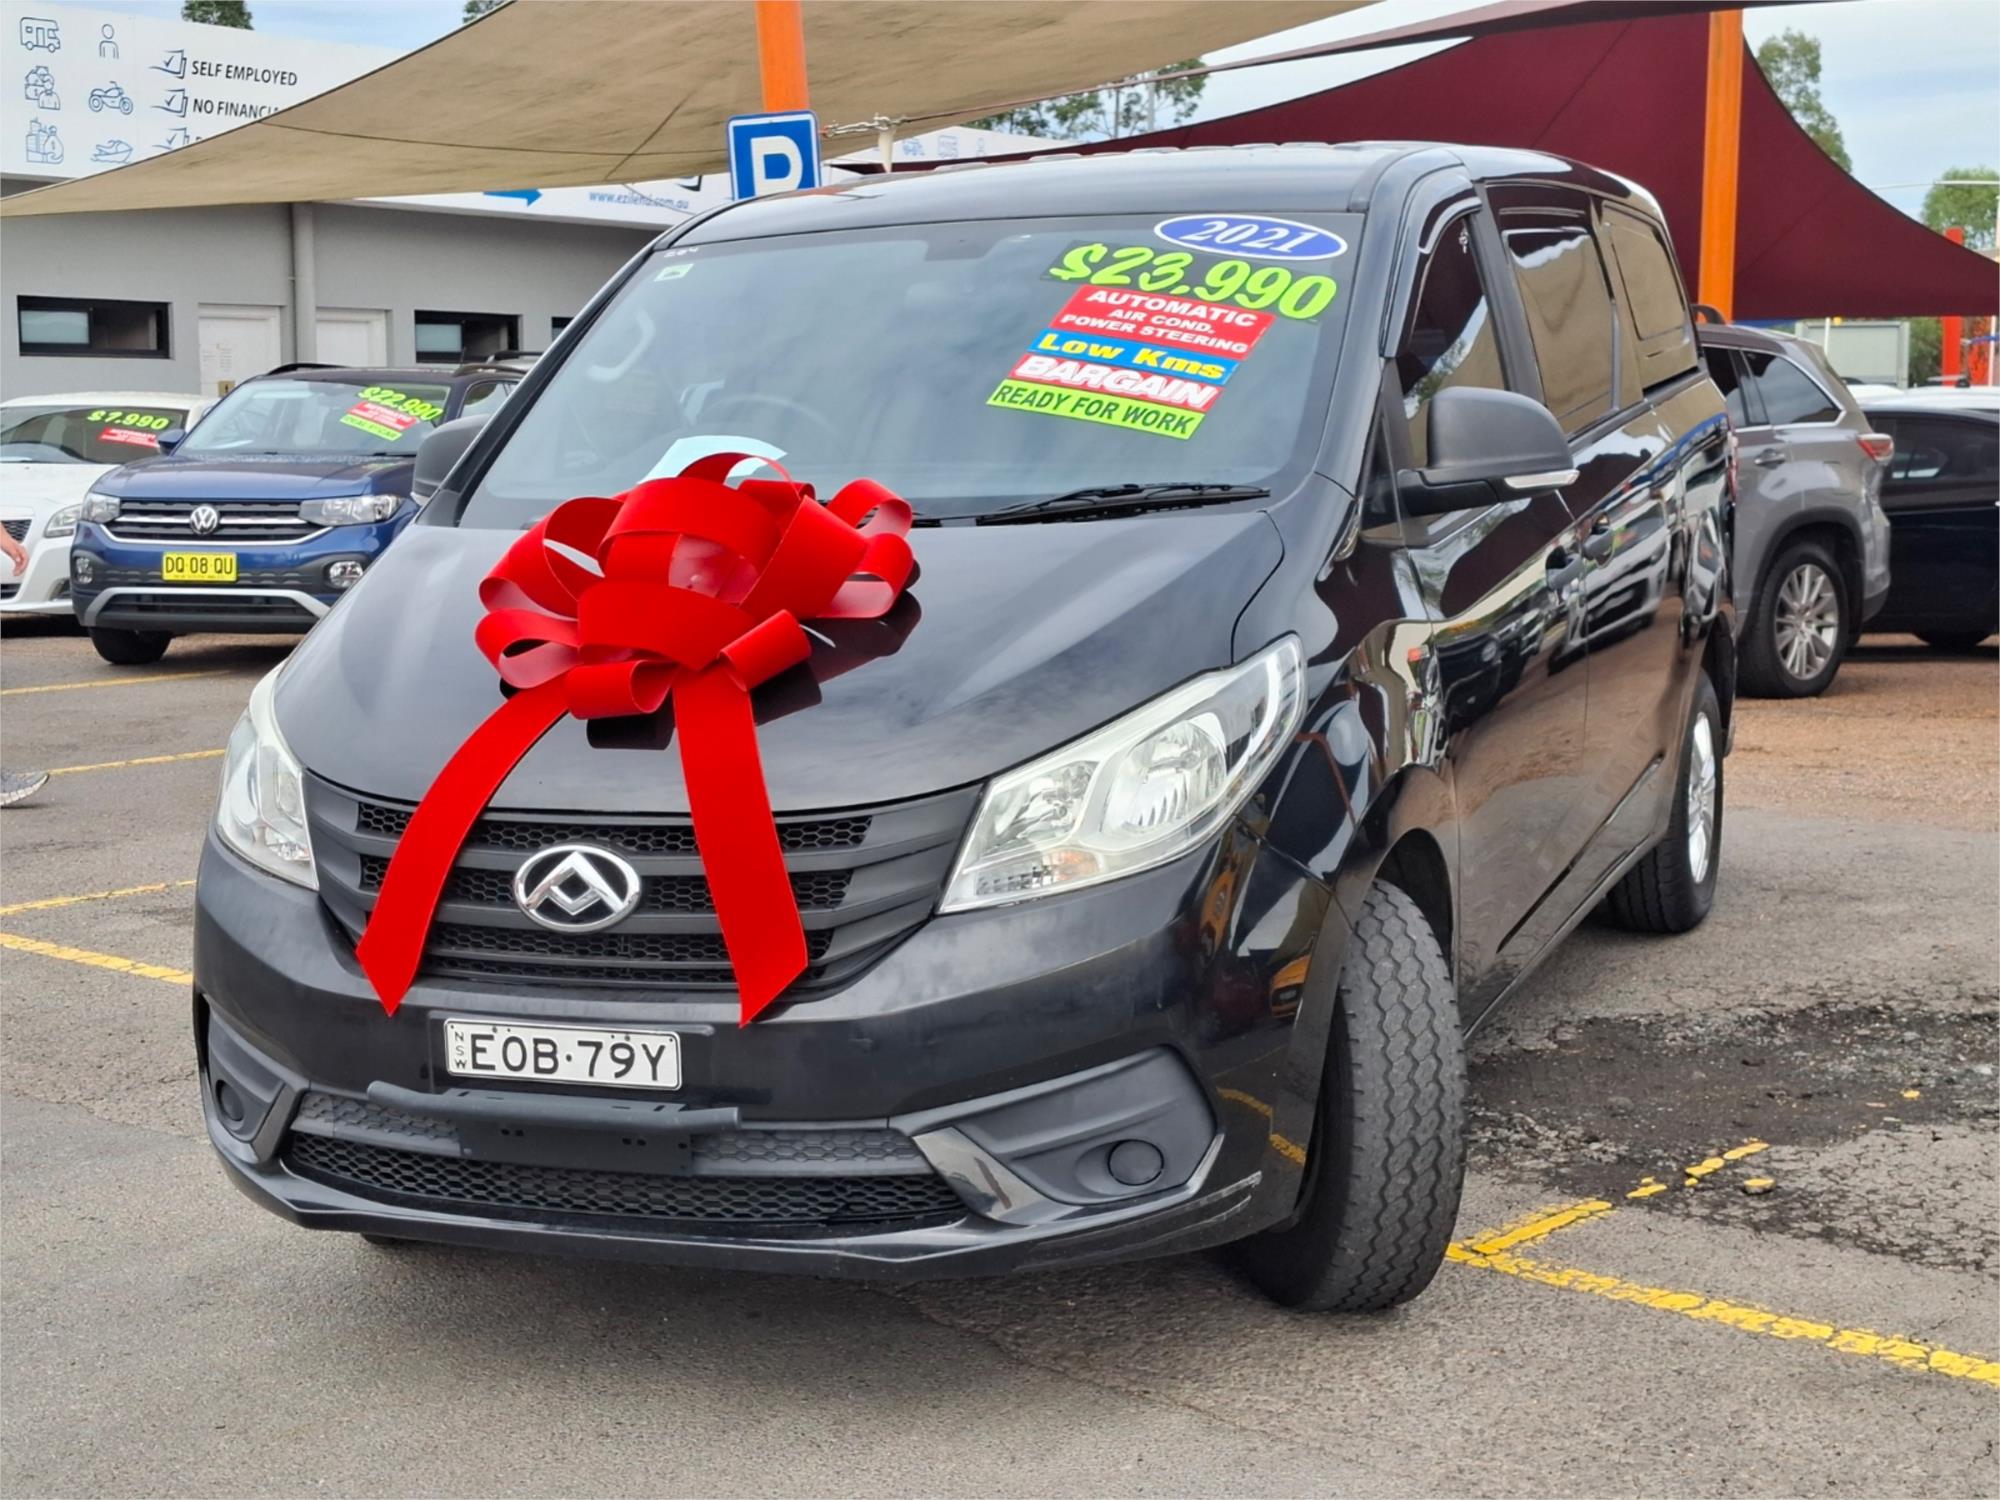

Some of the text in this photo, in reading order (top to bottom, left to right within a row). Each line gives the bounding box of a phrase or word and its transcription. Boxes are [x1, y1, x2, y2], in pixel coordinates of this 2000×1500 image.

[191, 60, 298, 86] SELF EMPLOYED
[193, 99, 279, 118] NO FINANCI
[1179, 219, 1320, 254] 2021
[1049, 242, 1338, 320] $23.990
[1086, 290, 1258, 328] AUTOMATIC
[1111, 308, 1216, 335] AIR COND.
[1060, 314, 1249, 354] POWER STEERING
[1037, 333, 1227, 379] Low Kms
[1015, 356, 1220, 408] BARGAIN
[86, 410, 170, 430] $7.990
[993, 384, 1196, 435] READY FOR WORK
